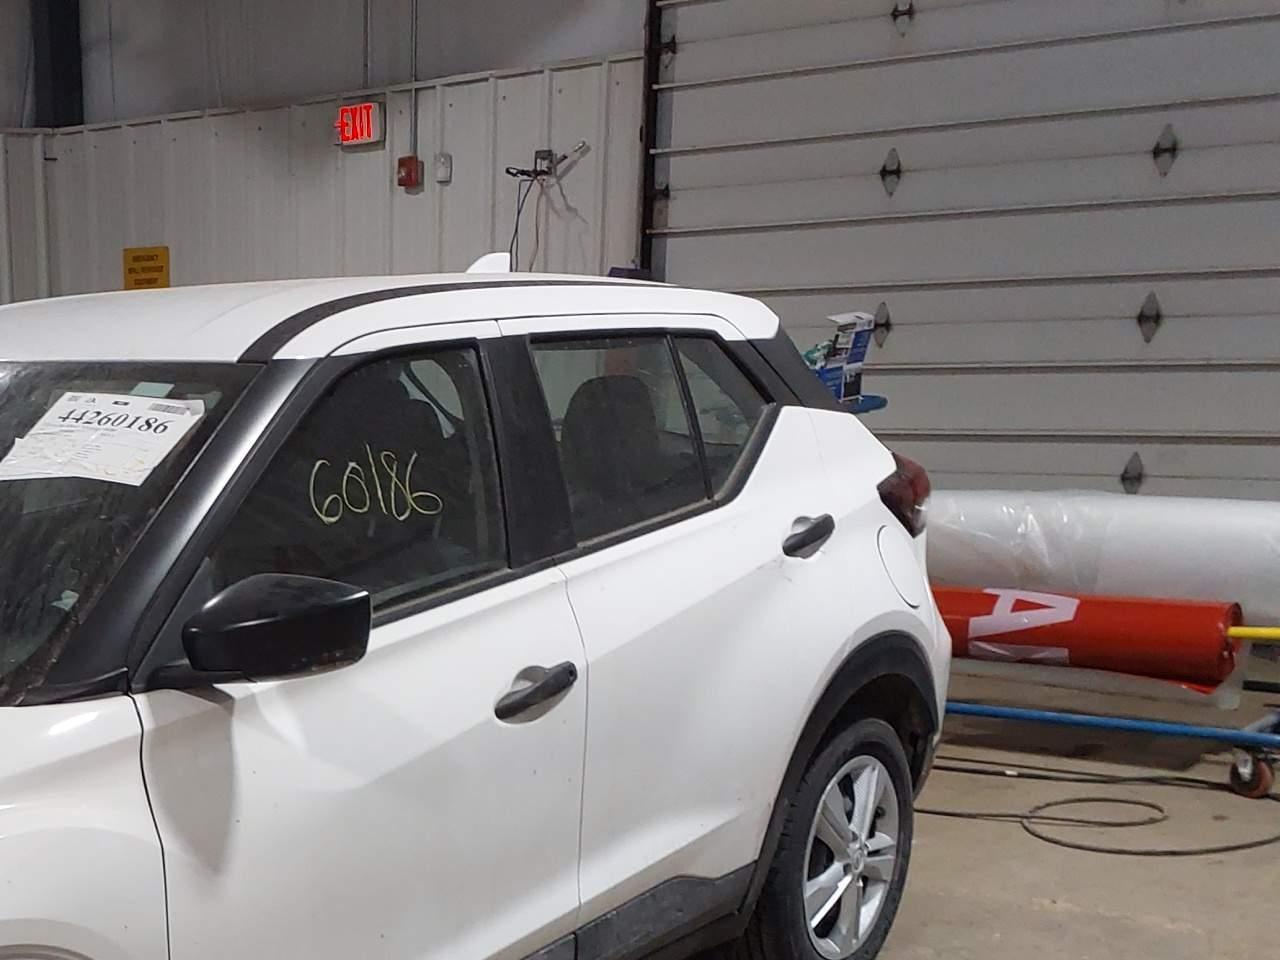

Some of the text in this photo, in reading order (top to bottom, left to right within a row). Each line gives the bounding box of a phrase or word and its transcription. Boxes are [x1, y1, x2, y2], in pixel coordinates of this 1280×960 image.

[339, 104, 373, 142] EXIT
[58, 408, 175, 435] 44260186
[309, 441, 444, 525] 60186
